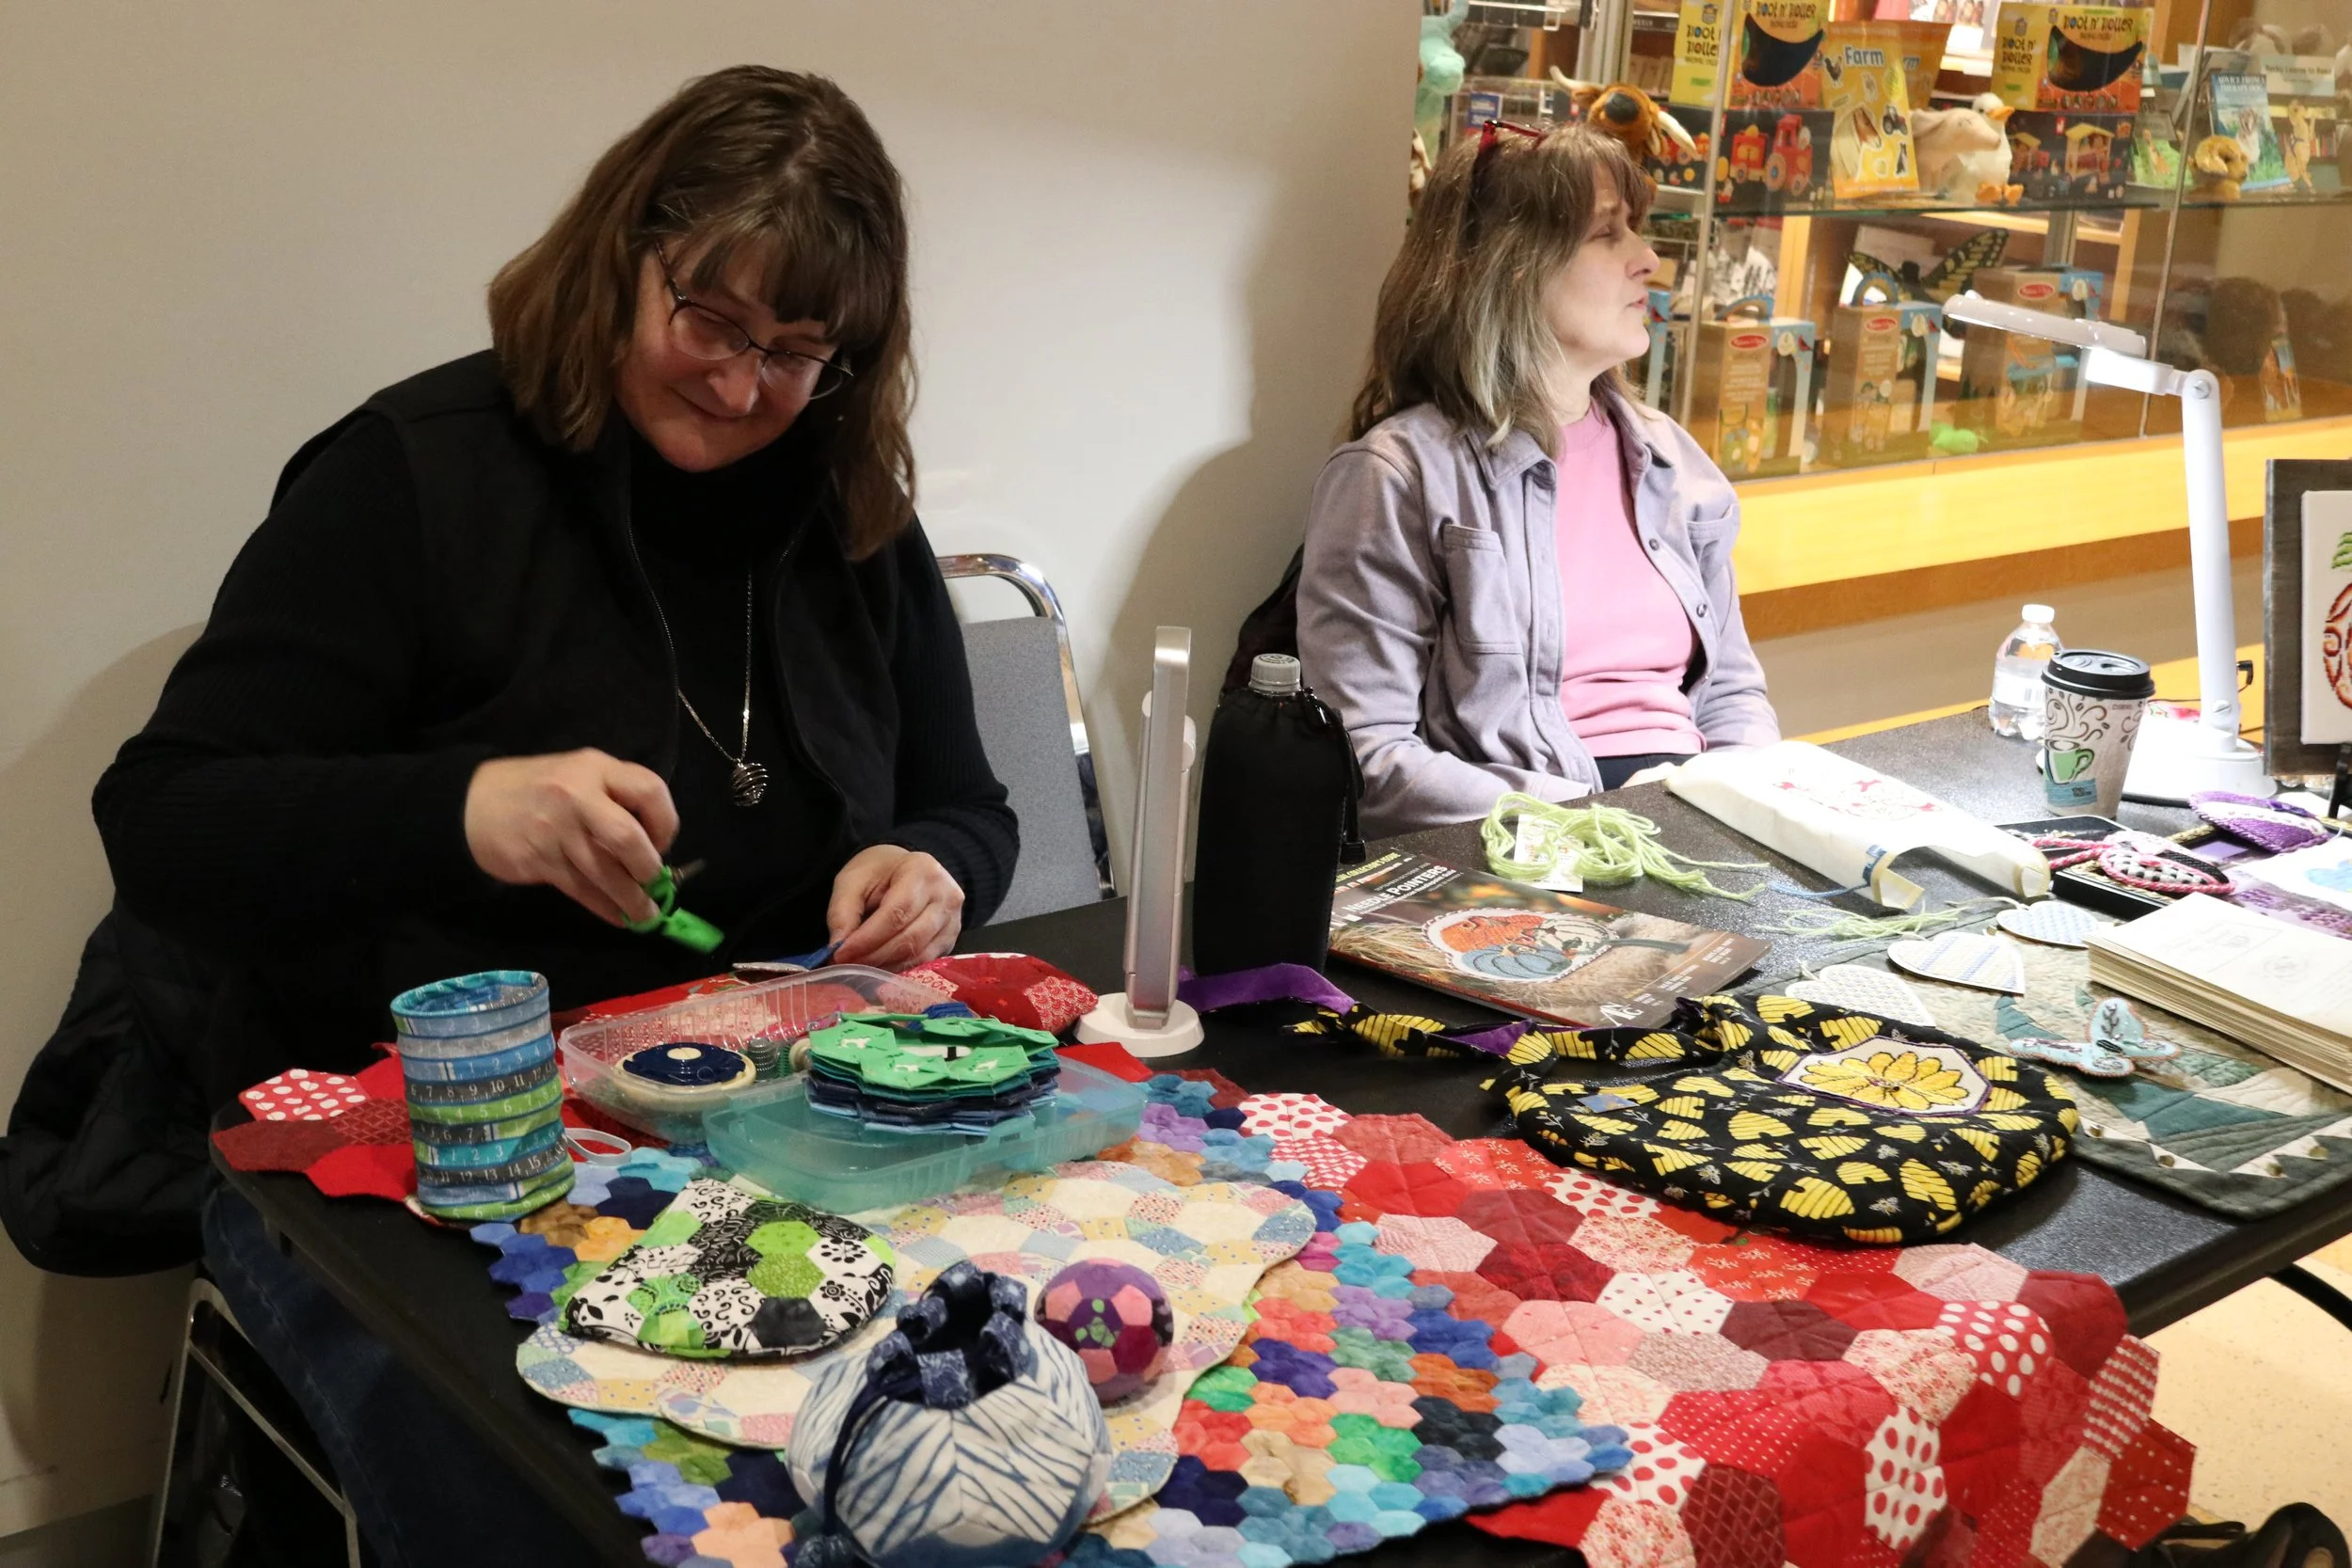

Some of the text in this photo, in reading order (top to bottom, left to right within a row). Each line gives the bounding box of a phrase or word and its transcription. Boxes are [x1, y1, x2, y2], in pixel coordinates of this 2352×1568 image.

[1844, 45, 1884, 66] Farm
[1342, 893, 1394, 912] NEEDLE
[1387, 865, 1448, 895] POINTERS
[447, 1085, 455, 1099] 8
[469, 1084, 478, 1097] 9
[490, 1079, 505, 1093] 10
[514, 1073, 526, 1087] 11
[479, 1105, 488, 1118] 5
[503, 1100, 513, 1114] 6
[443, 1129, 453, 1141] 6
[471, 1148, 480, 1161] 2
[495, 1145, 504, 1158] 3
[439, 1171, 450, 1183] 11
[459, 1170, 473, 1182] 12
[484, 1168, 498, 1181] 13
[508, 1163, 521, 1178] 14
[528, 1155, 542, 1170] 15
